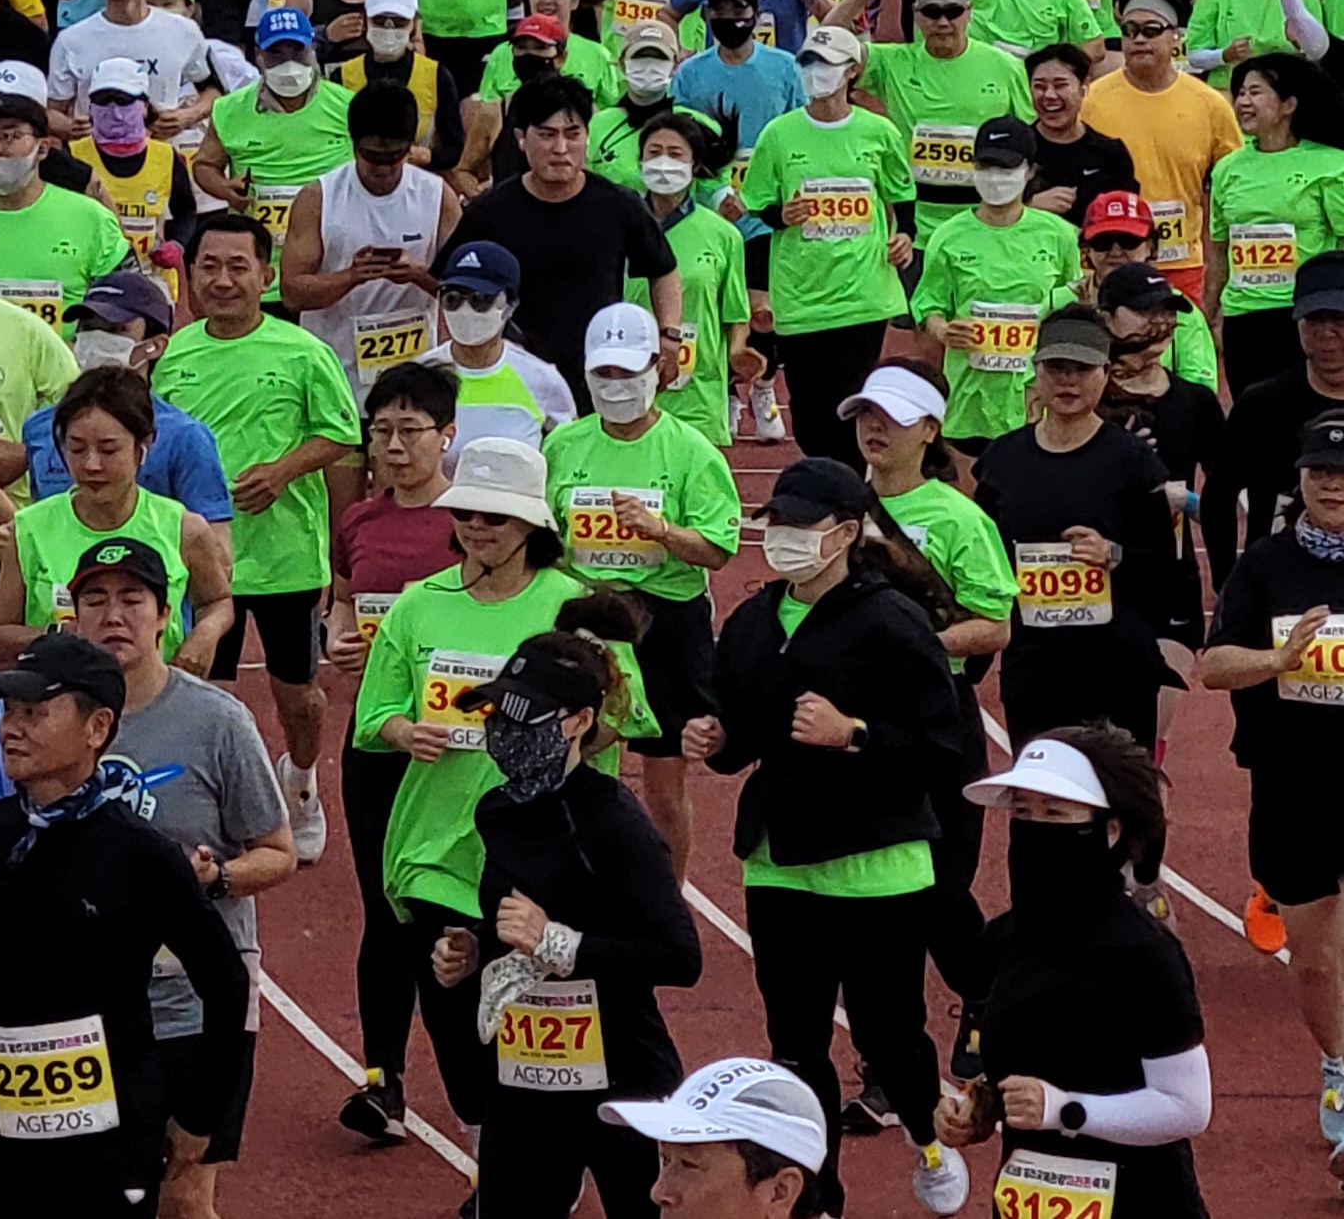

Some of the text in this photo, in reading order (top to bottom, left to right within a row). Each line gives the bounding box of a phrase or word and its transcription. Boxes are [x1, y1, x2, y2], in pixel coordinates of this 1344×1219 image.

[616, 1, 660, 20] 339
[914, 143, 973, 164] 2596
[807, 197, 869, 217] 3360
[1157, 219, 1183, 241] 61
[1231, 244, 1294, 265] 3122
[359, 328, 424, 359] 2277
[972, 323, 1036, 348] 3187
[1022, 569, 1105, 597] 3098
[1034, 607, 1095, 623] AGE20's
[500, 1010, 593, 1051] 3127
[513, 1065, 582, 1085] AGE20's
[15, 1110, 94, 1134] AGE20's
[1001, 1186, 1103, 1219] 3124
